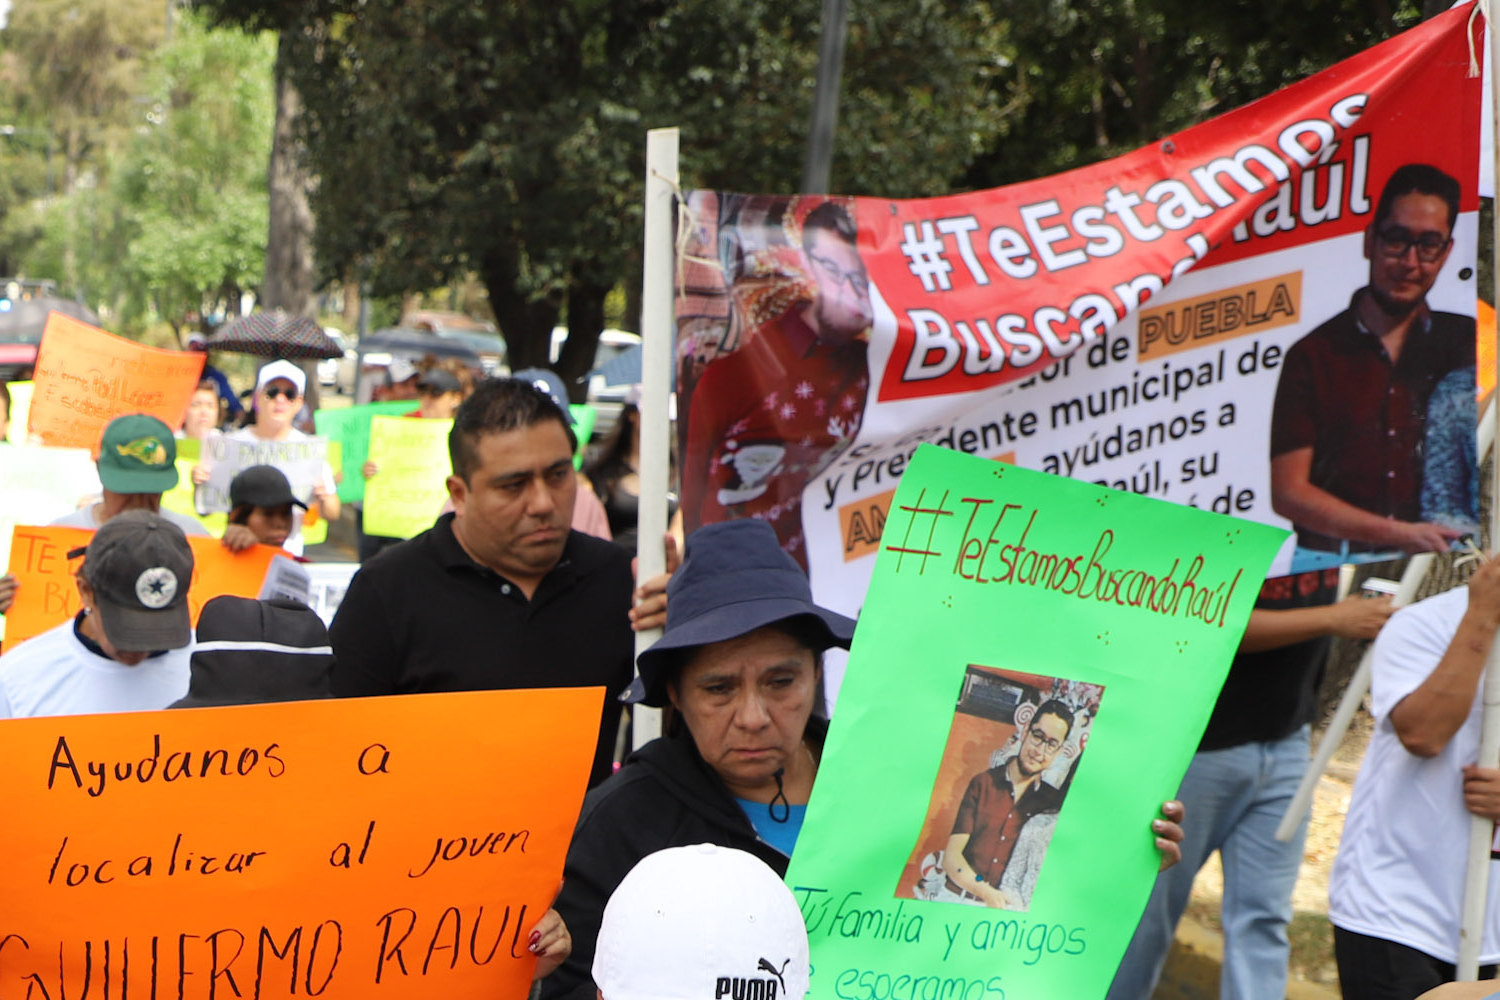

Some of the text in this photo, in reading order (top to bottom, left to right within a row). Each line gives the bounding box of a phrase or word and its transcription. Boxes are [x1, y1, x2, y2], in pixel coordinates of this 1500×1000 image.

[900, 93, 1370, 293] #TeEstamos
[1138, 284, 1296, 354] PUEBLA
[824, 473, 845, 511] y
[1049, 350, 1225, 430] municipal
[1236, 339, 1283, 376] de
[1041, 407, 1206, 478] ayúdanos
[1217, 401, 1237, 427] a
[1180, 451, 1219, 484] su
[47, 733, 391, 797] Ayudanos a
[47, 821, 530, 887] localizar al joven
[374, 904, 529, 984] RAUL
[943, 922, 961, 961] y
[971, 919, 1087, 966] amigos
